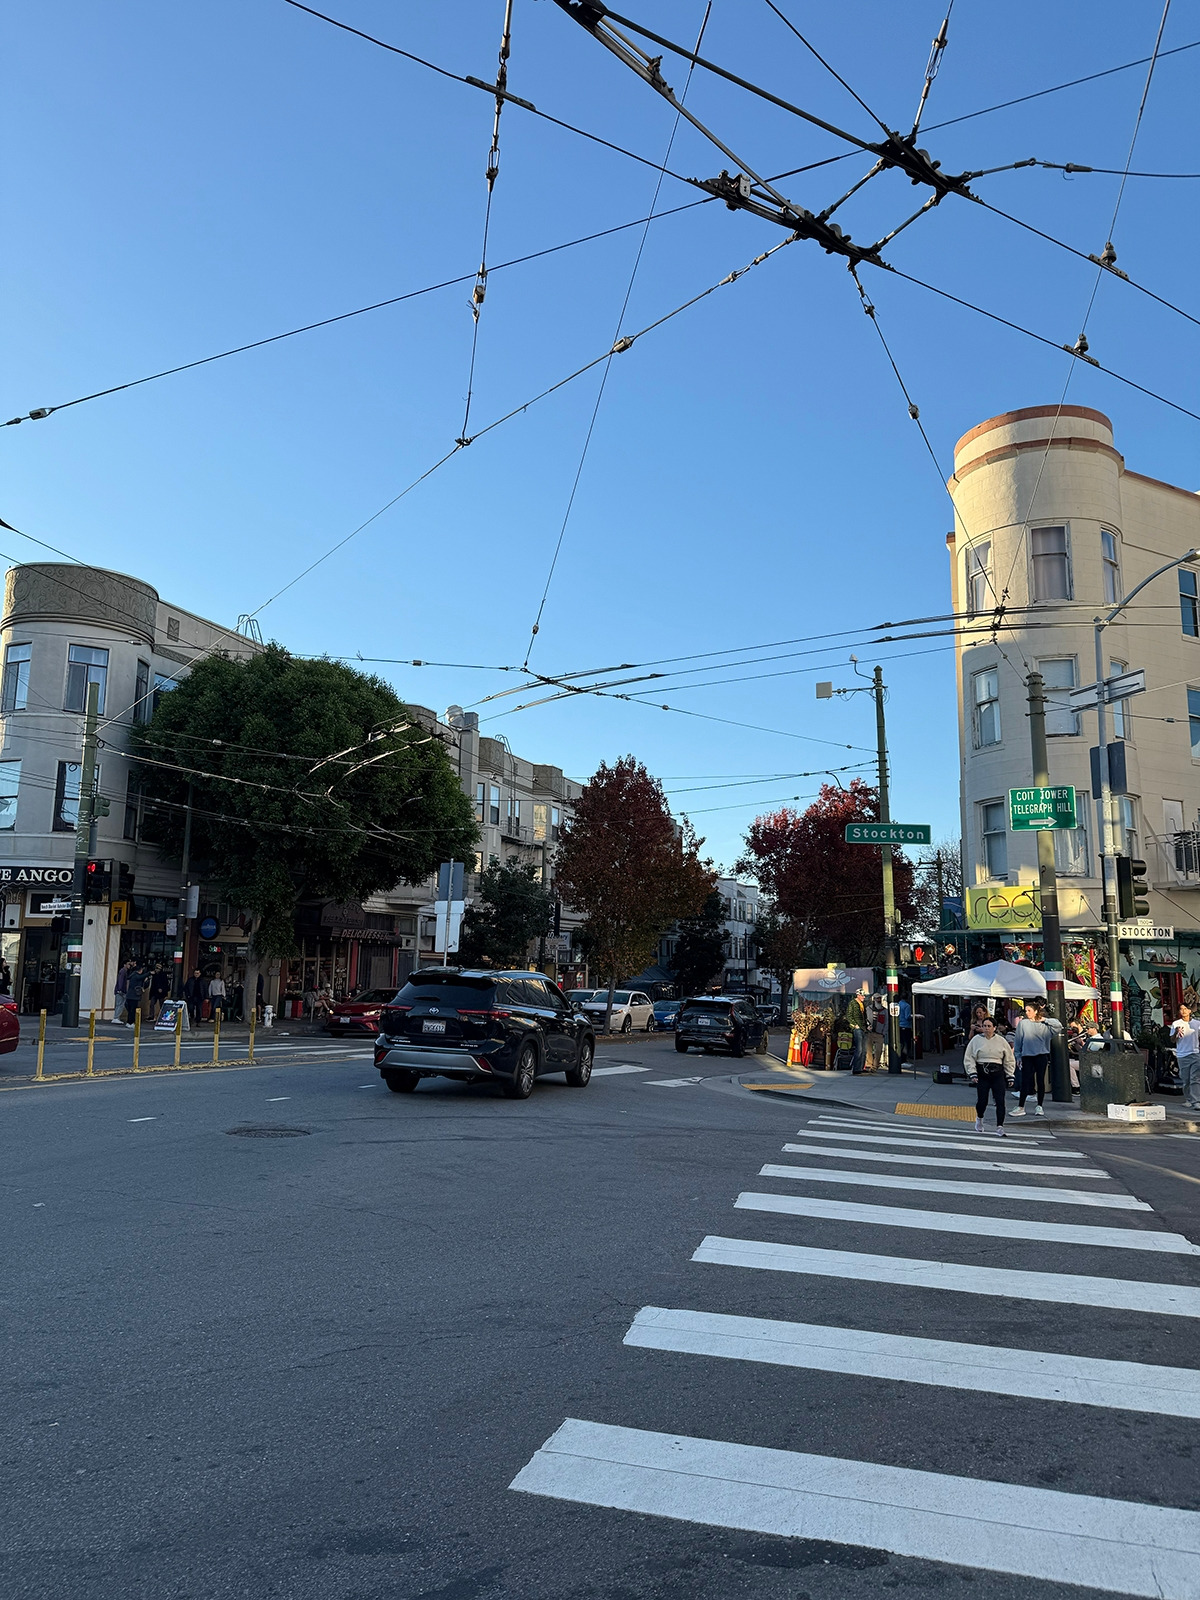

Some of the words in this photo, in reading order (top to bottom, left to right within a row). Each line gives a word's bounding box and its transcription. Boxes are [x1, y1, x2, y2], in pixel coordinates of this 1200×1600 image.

[1016, 791, 1035, 801] COIT
[1040, 789, 1068, 800] TOWER
[1013, 803, 1053, 814] TELEGRAPH
[1056, 802, 1073, 812] HILL
[852, 828, 924, 839] Stockton
[0, 868, 12, 881] E
[15, 868, 75, 883] ANGO
[1121, 926, 1171, 937] STOCKTON
